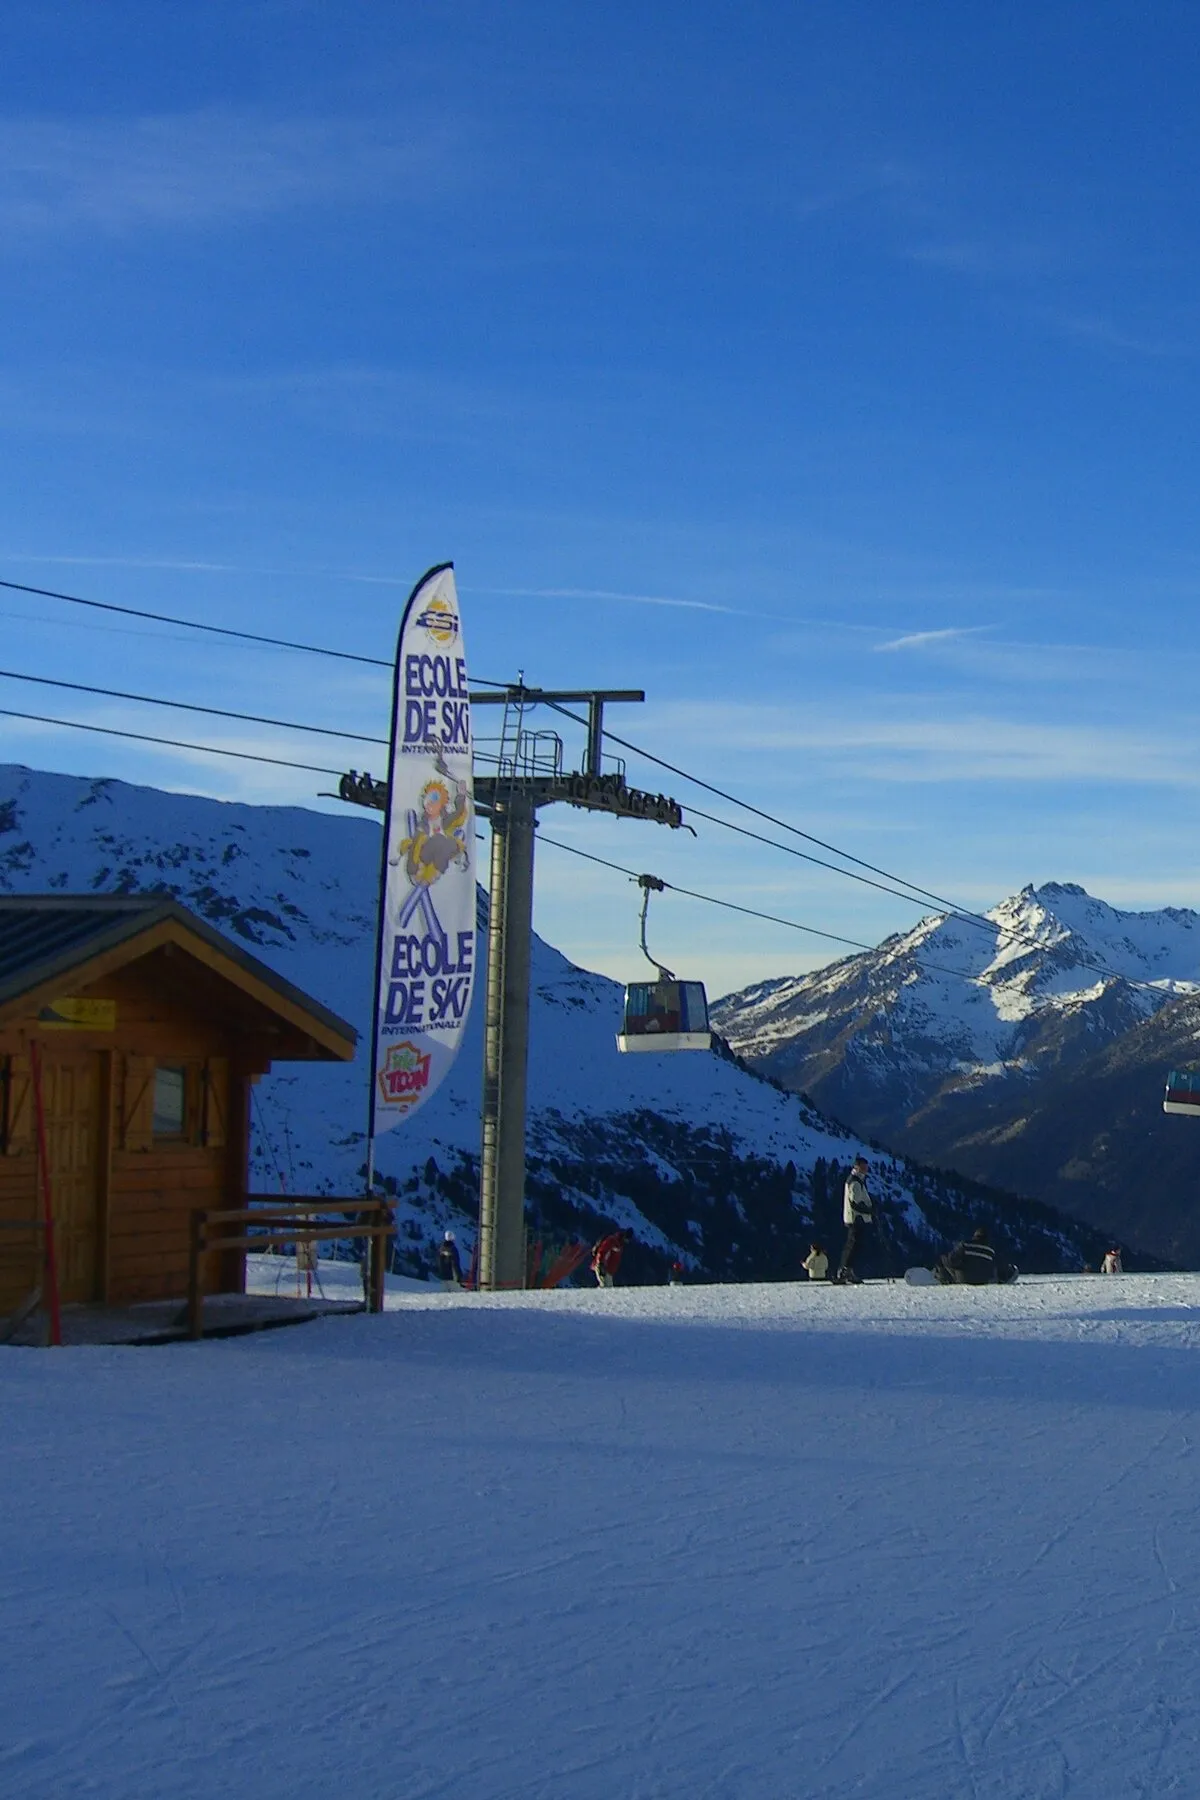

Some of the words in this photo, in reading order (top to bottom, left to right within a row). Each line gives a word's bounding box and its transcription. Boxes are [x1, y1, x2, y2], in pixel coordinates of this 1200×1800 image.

[405, 654, 468, 698] ECOLE
[404, 700, 436, 743] DE
[391, 931, 473, 979] ECOLE
[384, 981, 424, 1025] DE
